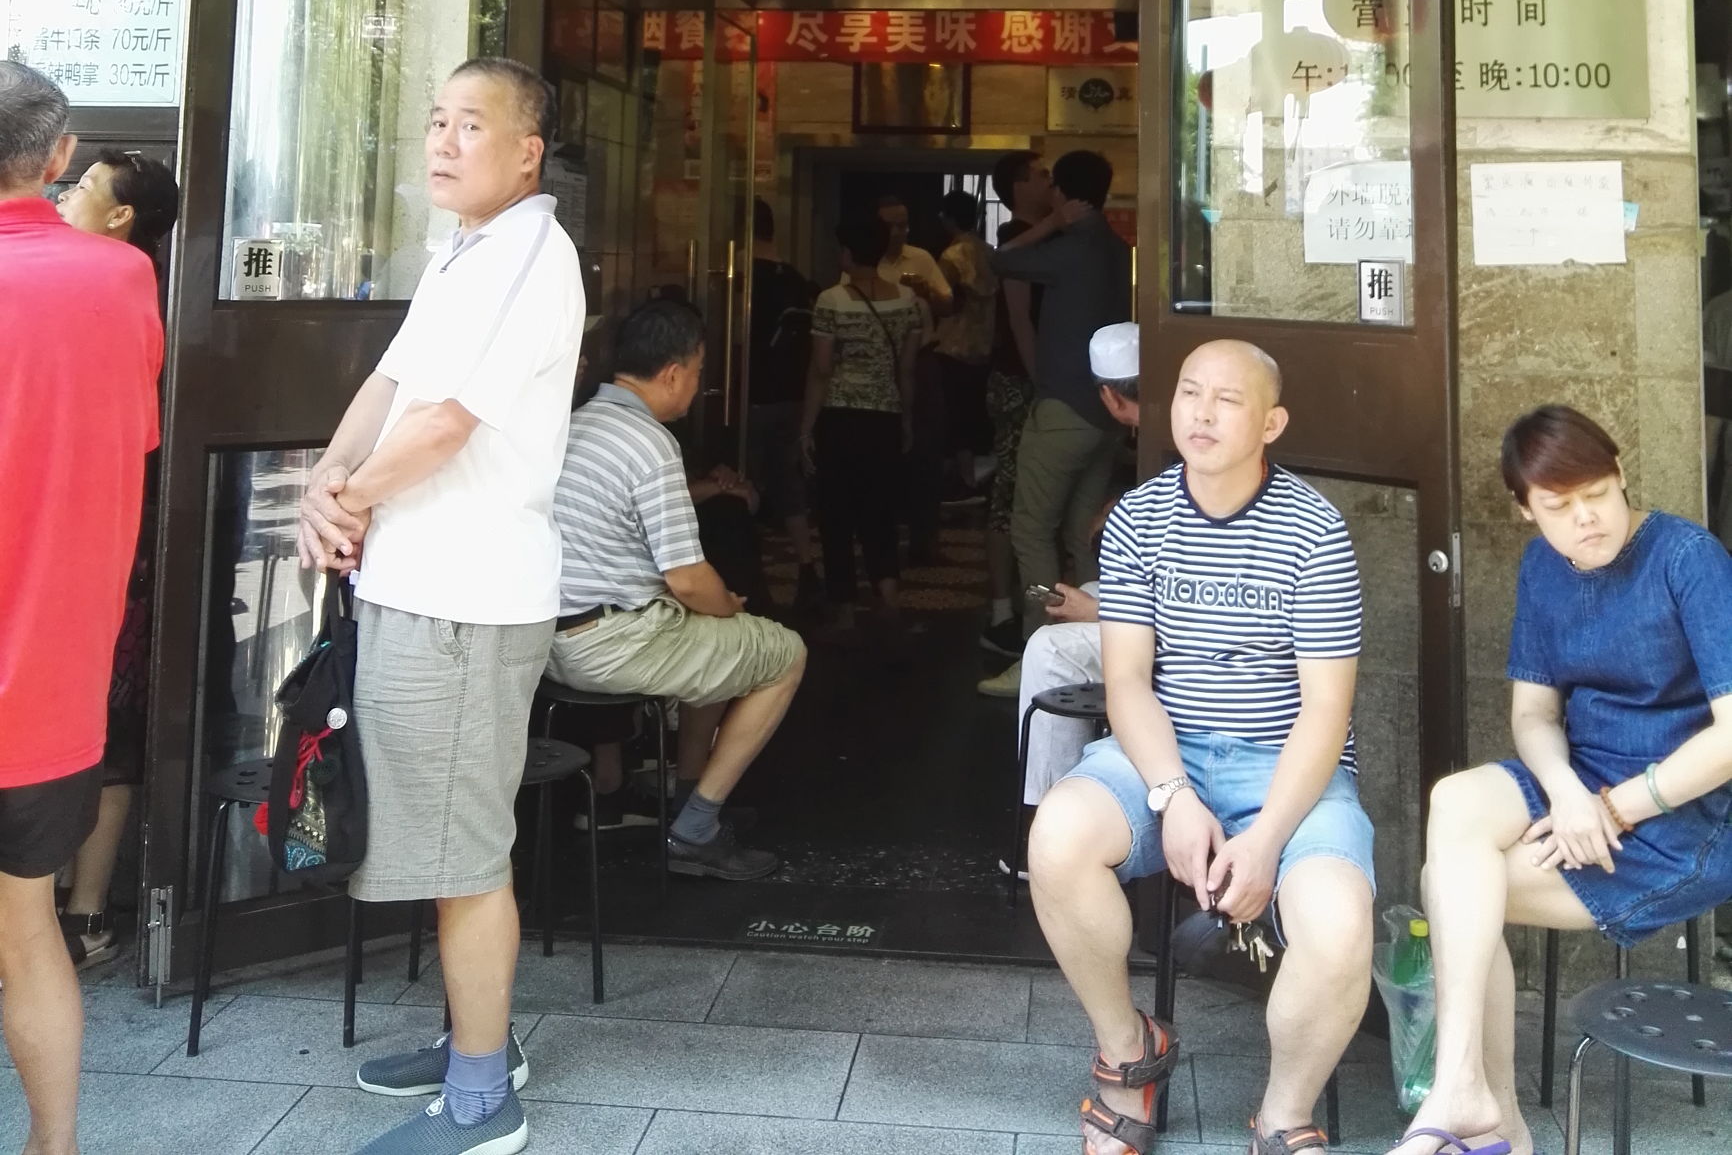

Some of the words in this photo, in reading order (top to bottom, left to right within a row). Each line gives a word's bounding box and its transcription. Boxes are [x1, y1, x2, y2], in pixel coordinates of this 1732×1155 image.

[34, 62, 99, 87] 辣鸭掌
[109, 63, 170, 88] 30元/斤
[243, 247, 273, 278] 推
[244, 284, 272, 293] PUSH
[1367, 268, 1394, 300] 推
[1369, 307, 1394, 316] PUSH
[748, 920, 876, 938] 小心台阶
